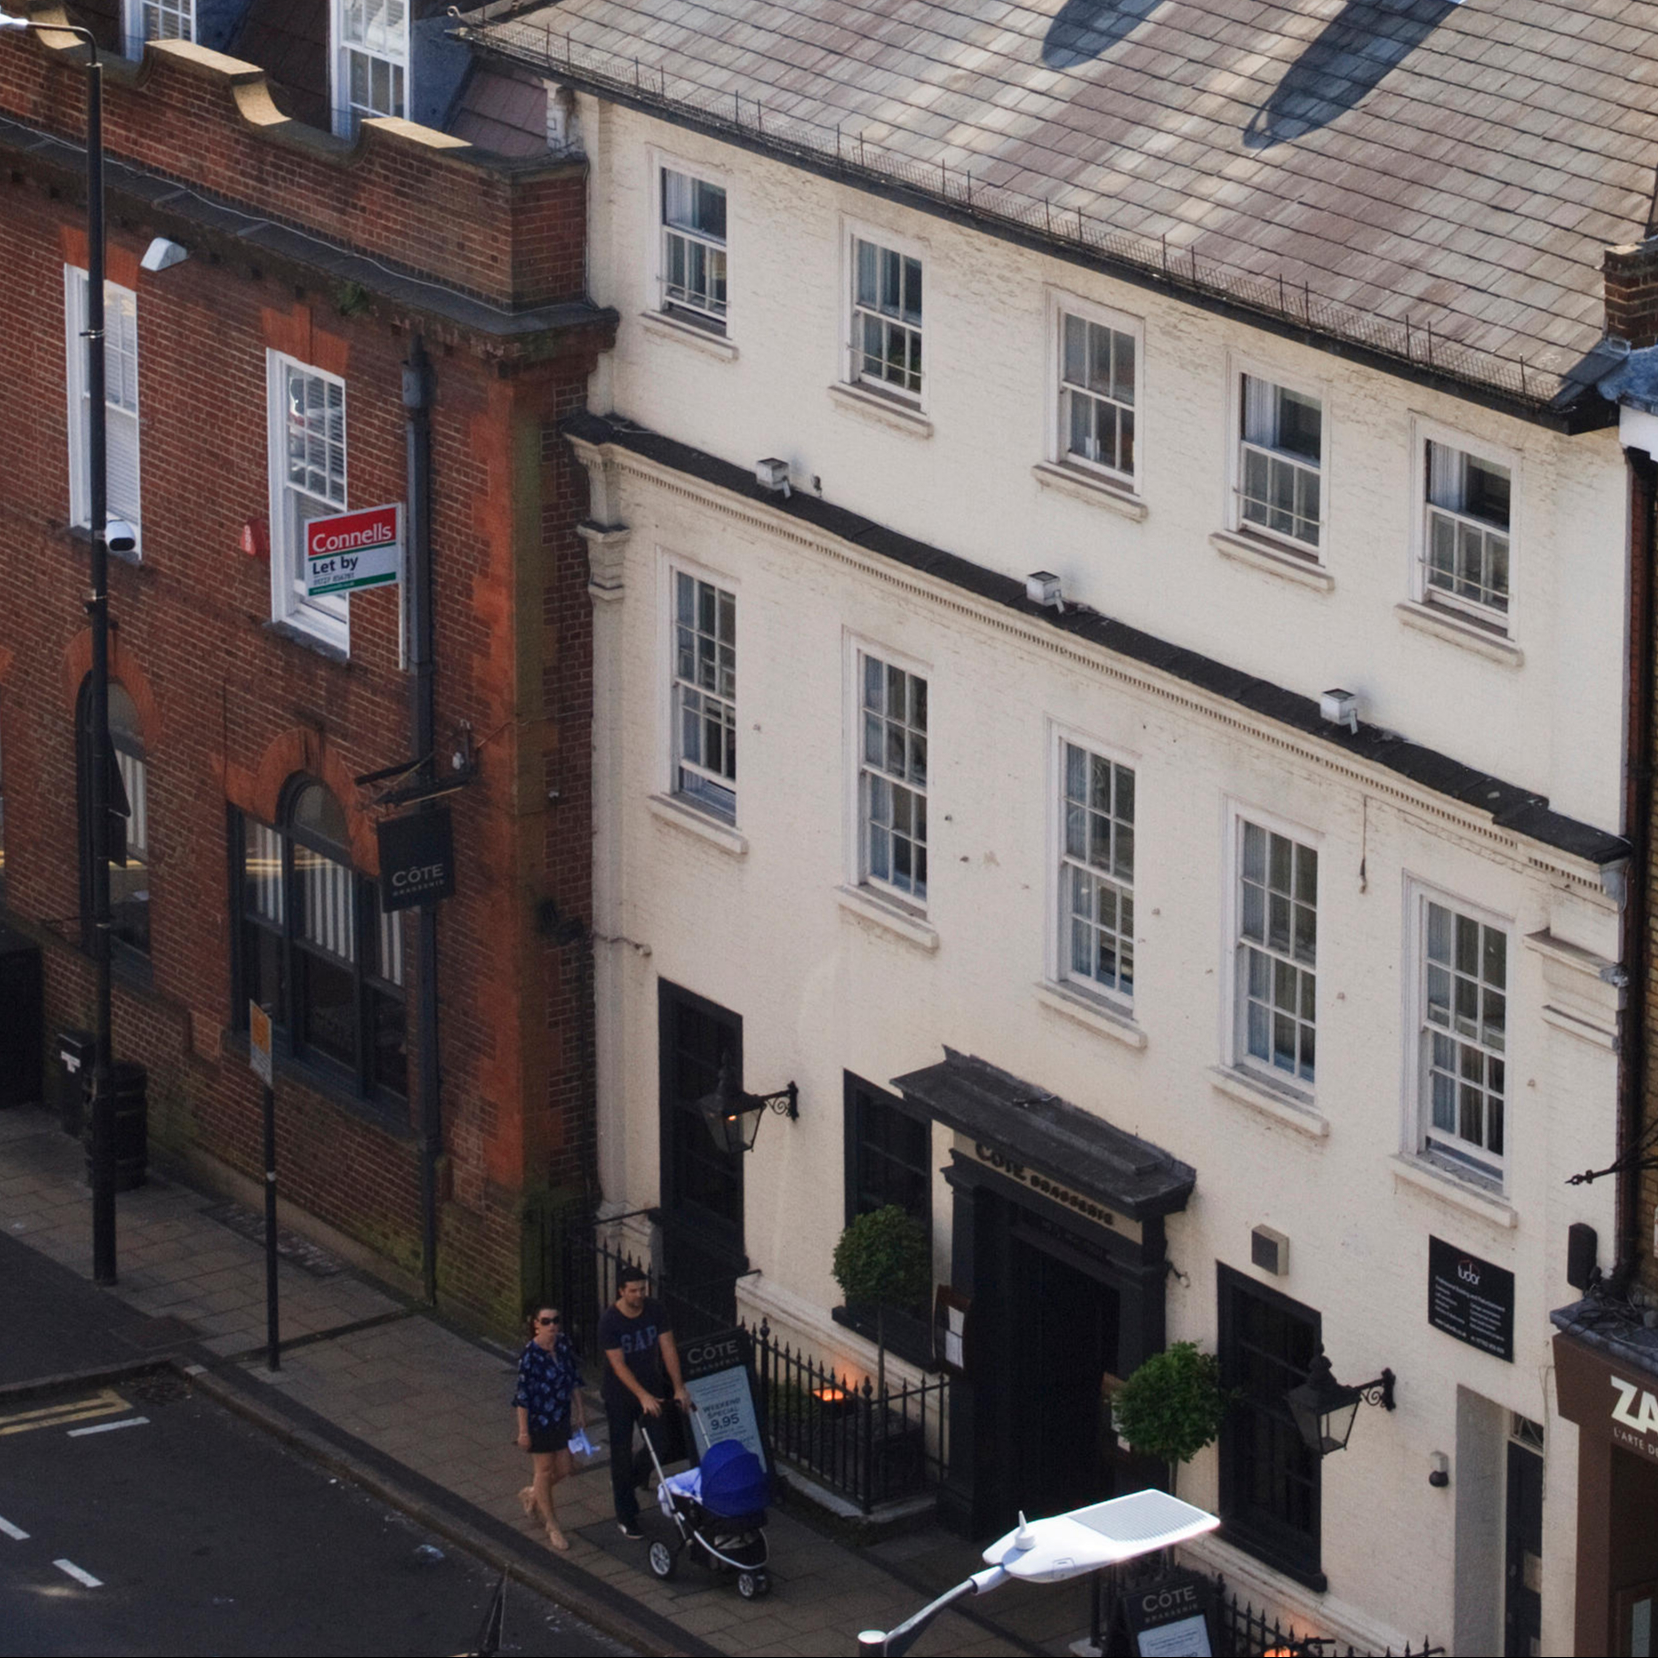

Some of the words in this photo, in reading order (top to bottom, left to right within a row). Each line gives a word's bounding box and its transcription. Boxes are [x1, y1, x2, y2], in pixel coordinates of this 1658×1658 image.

[312, 522, 392, 553] Connells
[312, 559, 335, 575] Let
[341, 556, 359, 572] by
[392, 863, 444, 888] CÔTE
[1030, 1174, 1114, 1226] BRASSERIE
[1457, 1262, 1480, 1285] tudor
[620, 1325, 658, 1354] GAP
[687, 1340, 739, 1365] CÔTE
[703, 1397, 741, 1413] WEEKEND
[707, 1407, 739, 1420] SPECIAL
[710, 1413, 740, 1431] 9.95
[1613, 1427, 1645, 1451] L'ARTE
[1142, 1585, 1197, 1613] CÔTE
